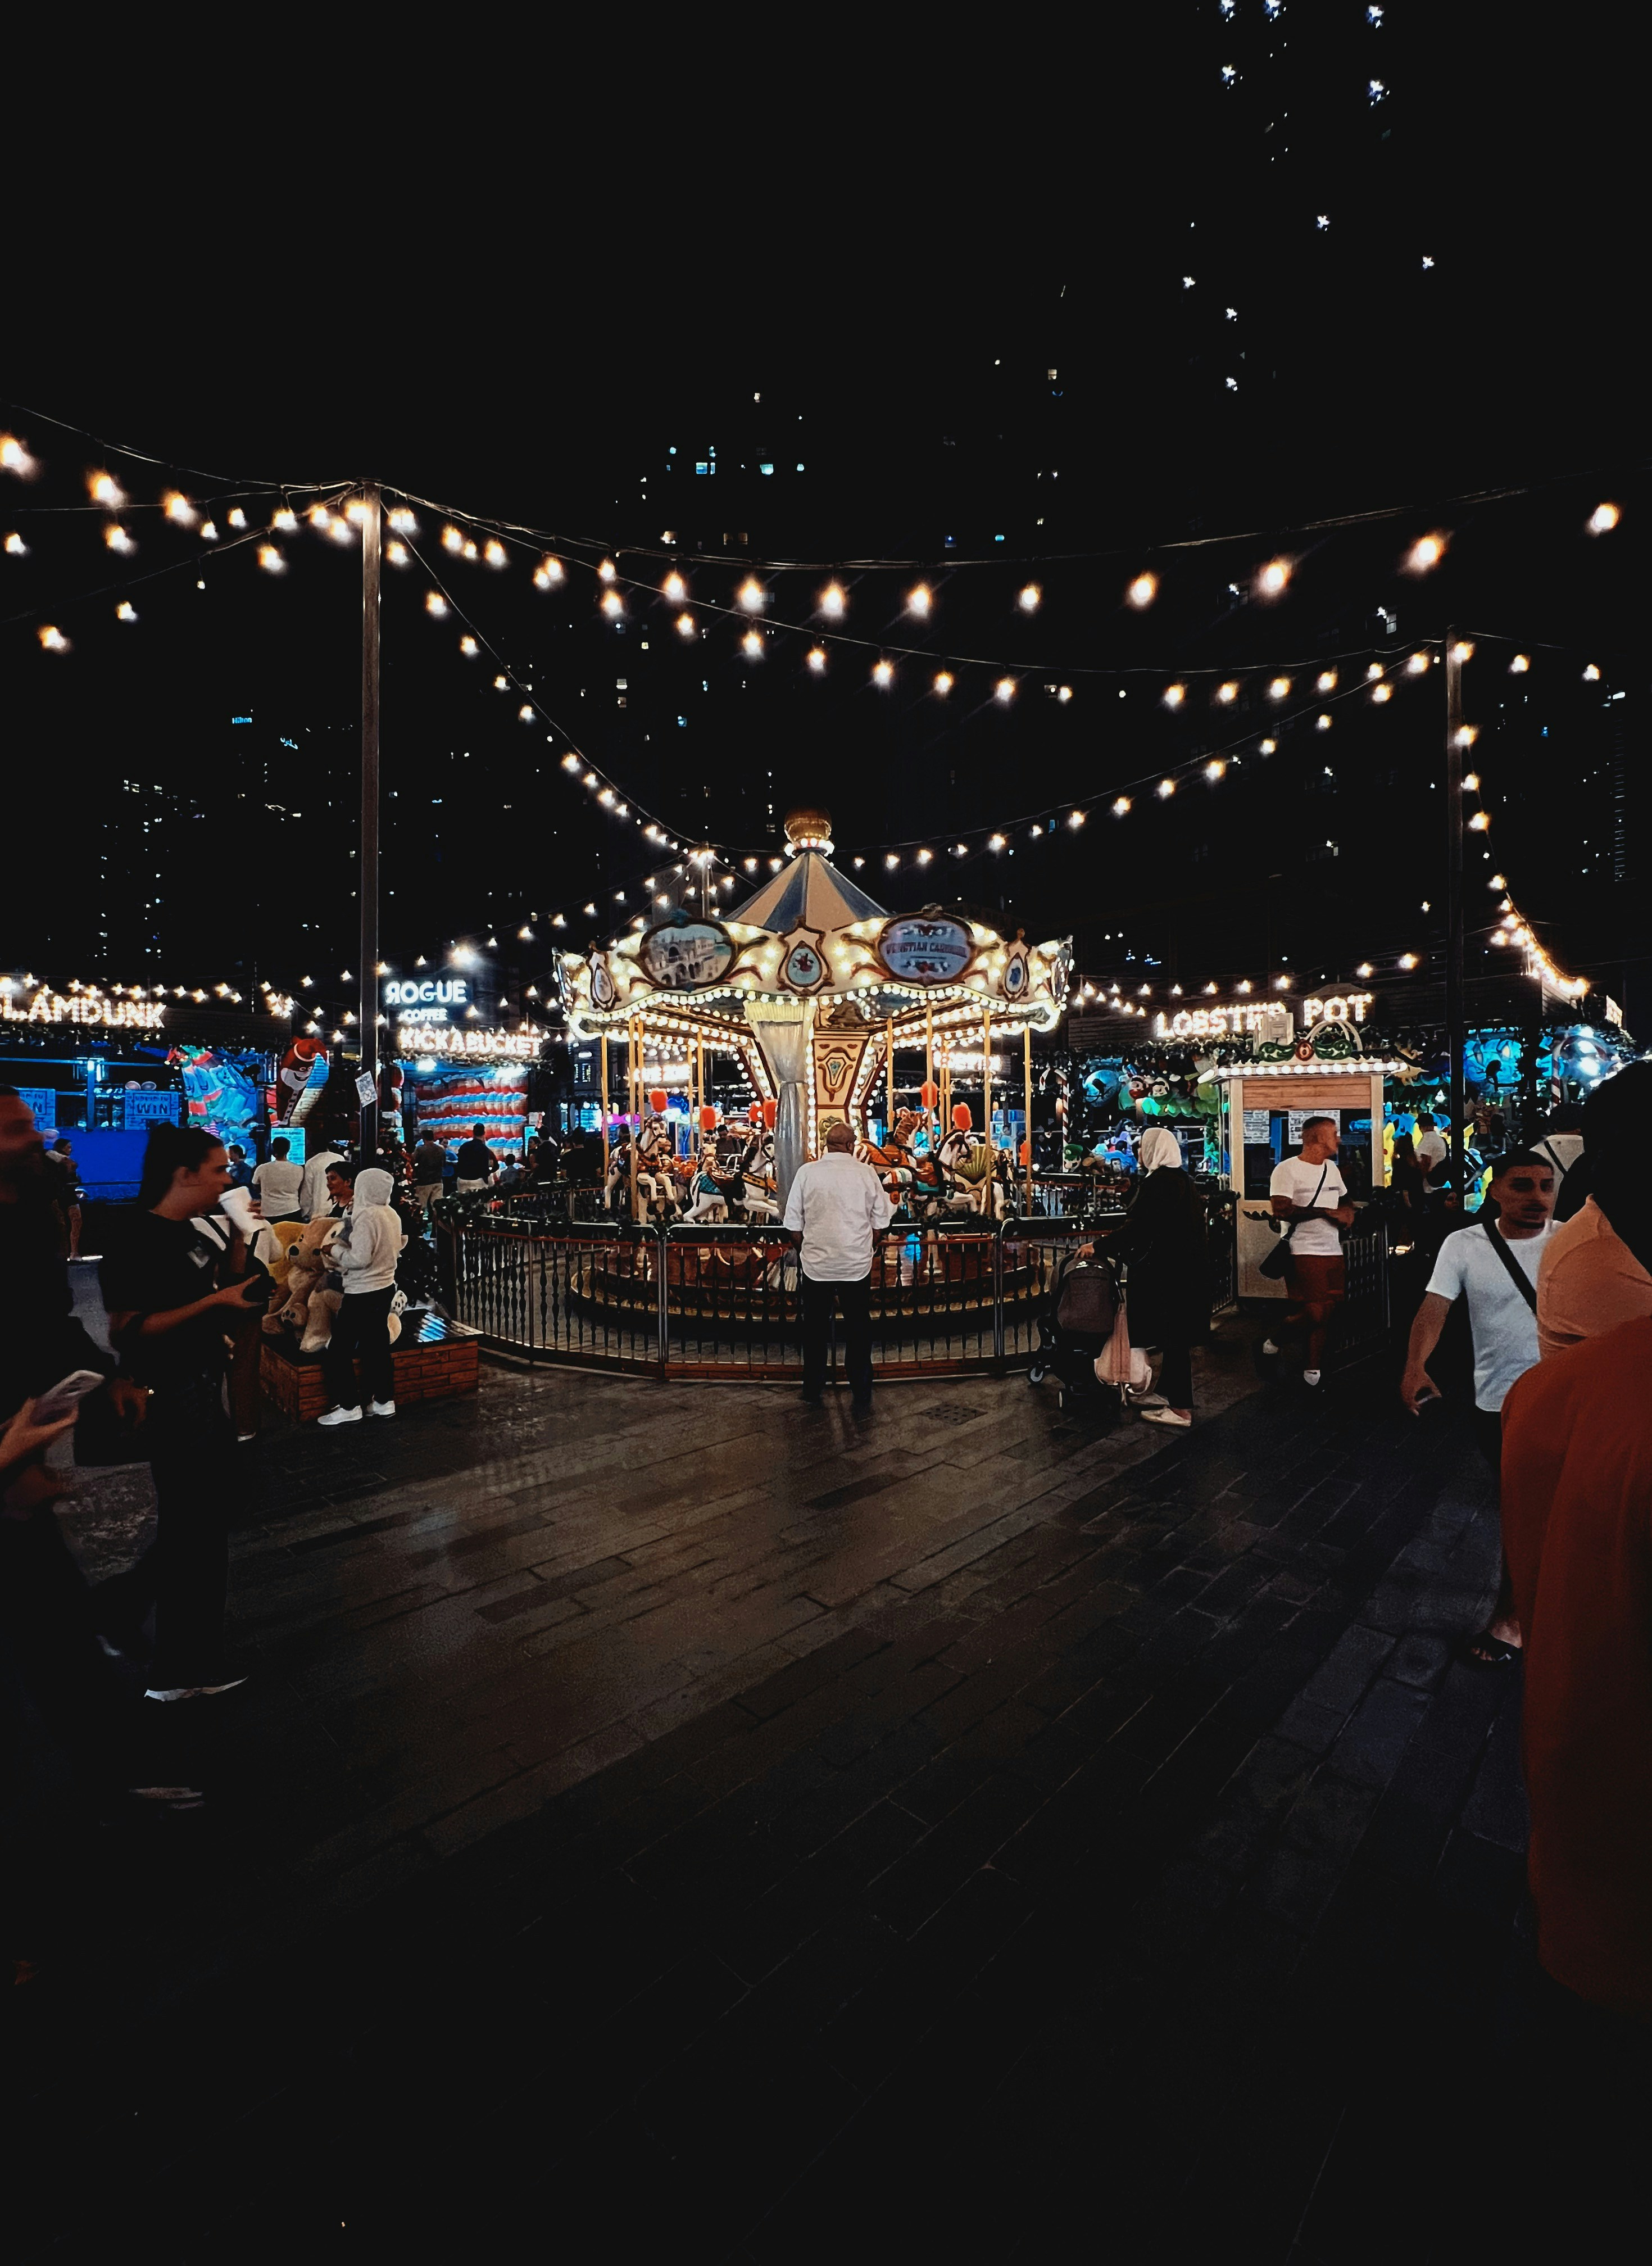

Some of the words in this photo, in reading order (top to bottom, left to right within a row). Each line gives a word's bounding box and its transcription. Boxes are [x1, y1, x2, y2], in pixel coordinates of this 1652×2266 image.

[0, 991, 167, 1028] LAMDUNK
[1303, 994, 1373, 1027] POT
[137, 1103, 168, 1114] WIN
